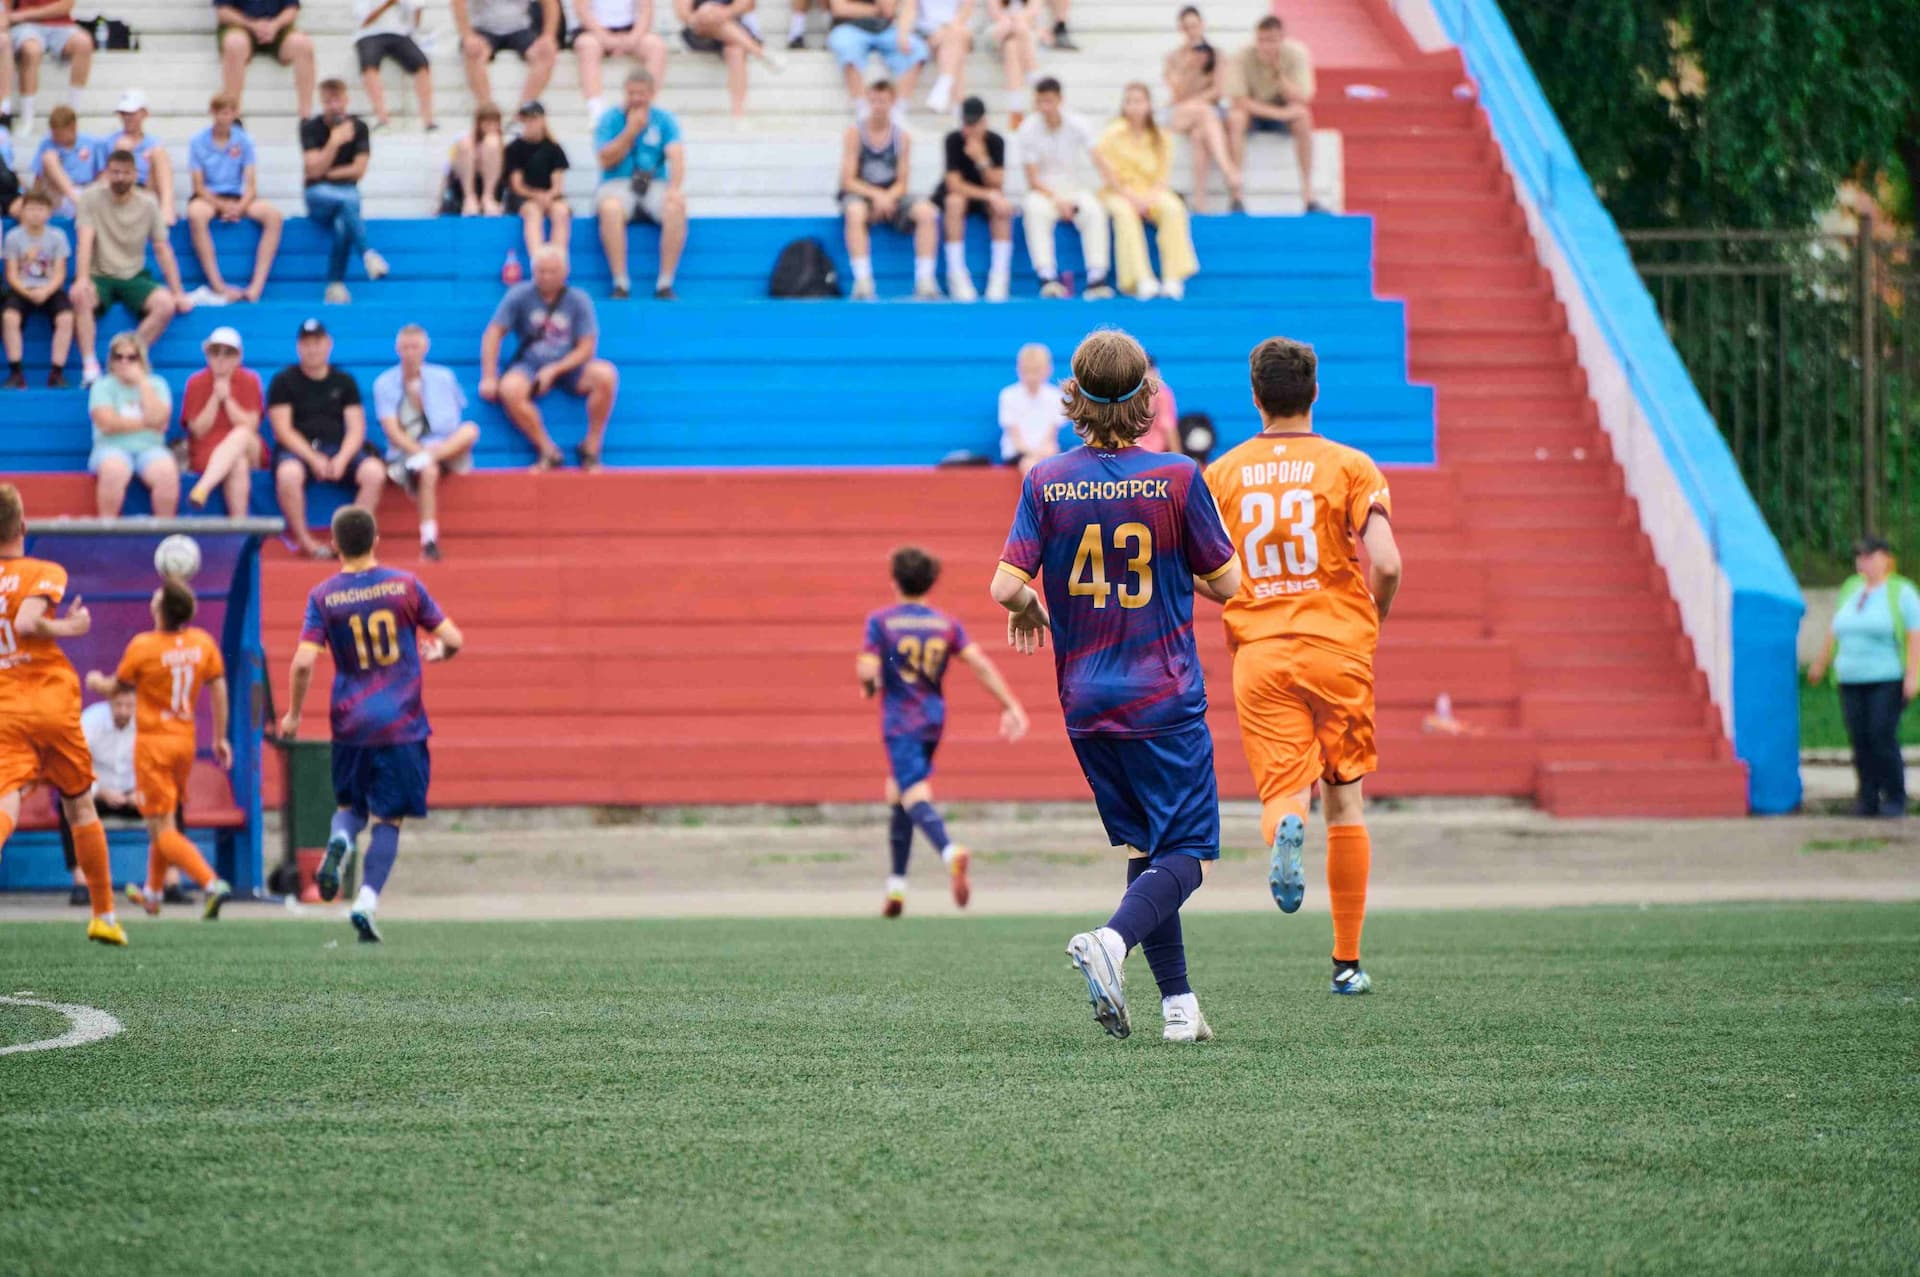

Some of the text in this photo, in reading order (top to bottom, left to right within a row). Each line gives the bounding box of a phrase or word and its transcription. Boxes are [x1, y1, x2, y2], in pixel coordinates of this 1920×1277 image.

[1043, 479, 1168, 502] КРАСНОЯРСК
[1241, 488, 1318, 579] 23
[1068, 522, 1153, 609] 43
[325, 582, 406, 608] КРАСНОЯРСК
[348, 609, 399, 670] 10
[171, 664, 194, 713] 11
